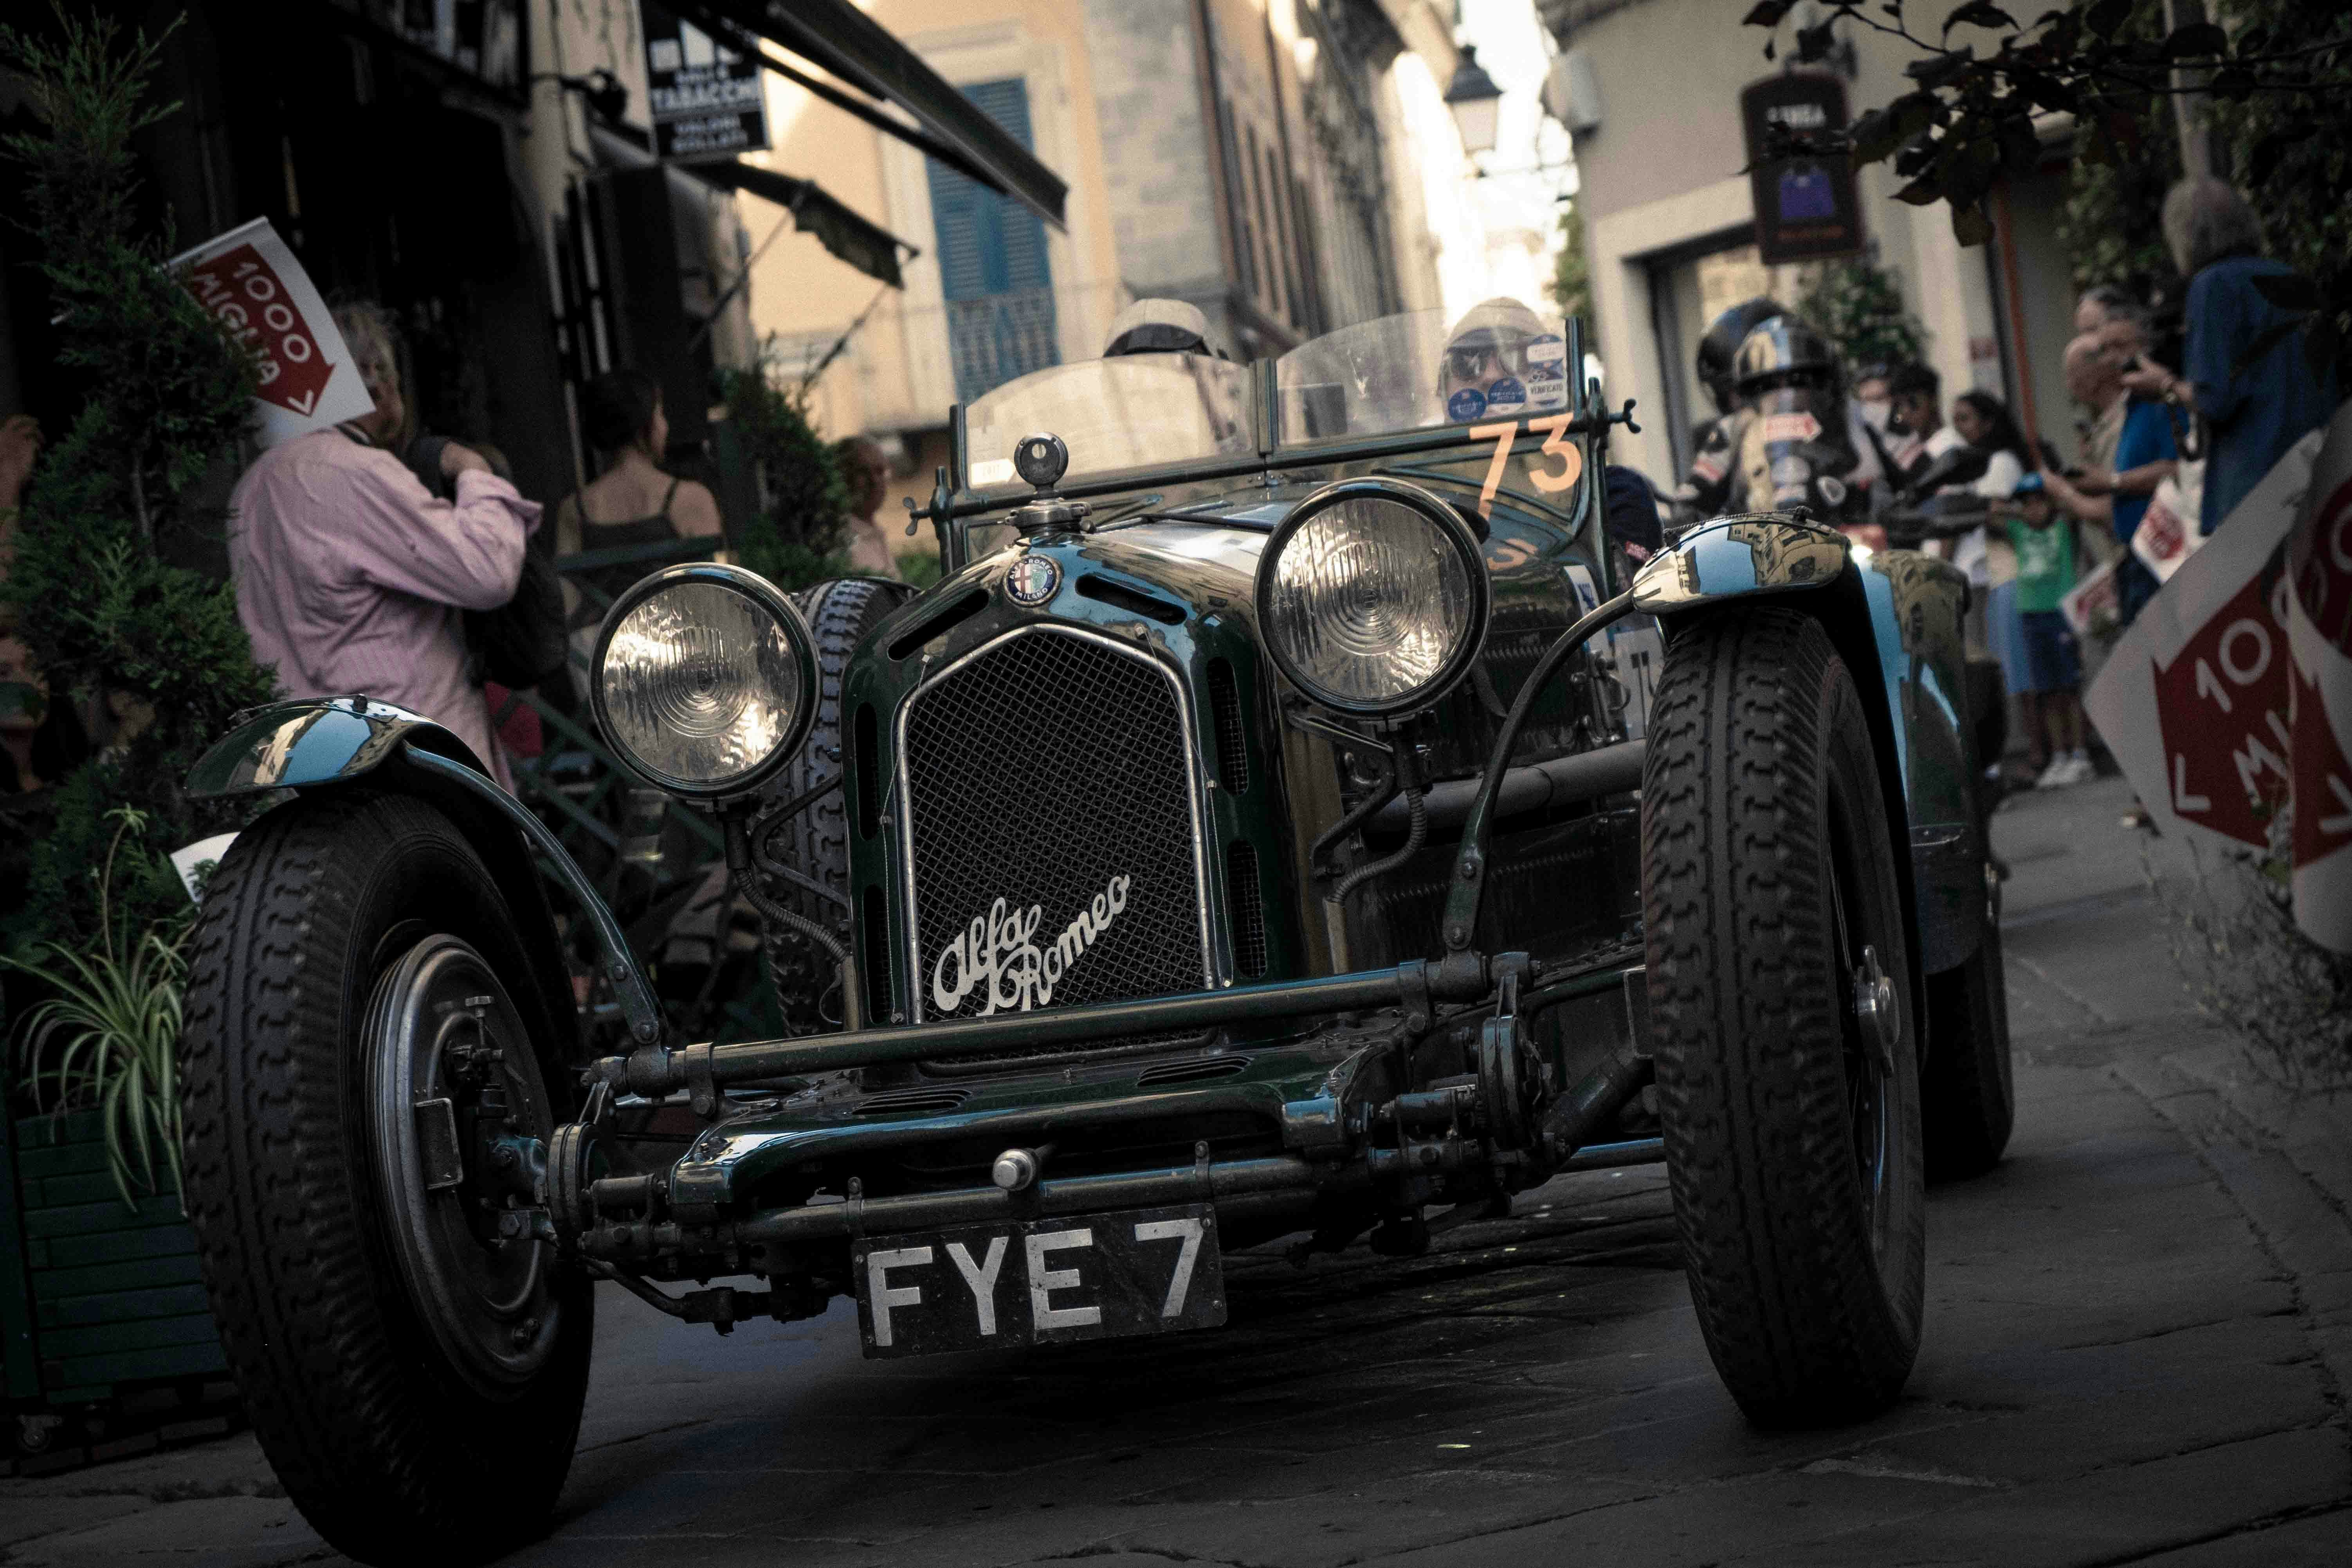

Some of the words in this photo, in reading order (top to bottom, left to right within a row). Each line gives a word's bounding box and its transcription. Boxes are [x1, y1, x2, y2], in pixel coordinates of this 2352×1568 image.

[233, 262, 312, 363] 1000
[1469, 411, 1582, 502] 73
[1015, 588, 1048, 600] MILANO
[993, 875, 1130, 1011] Romeo
[868, 1228, 1101, 1346] FYE
[1134, 1218, 1203, 1317] 7
